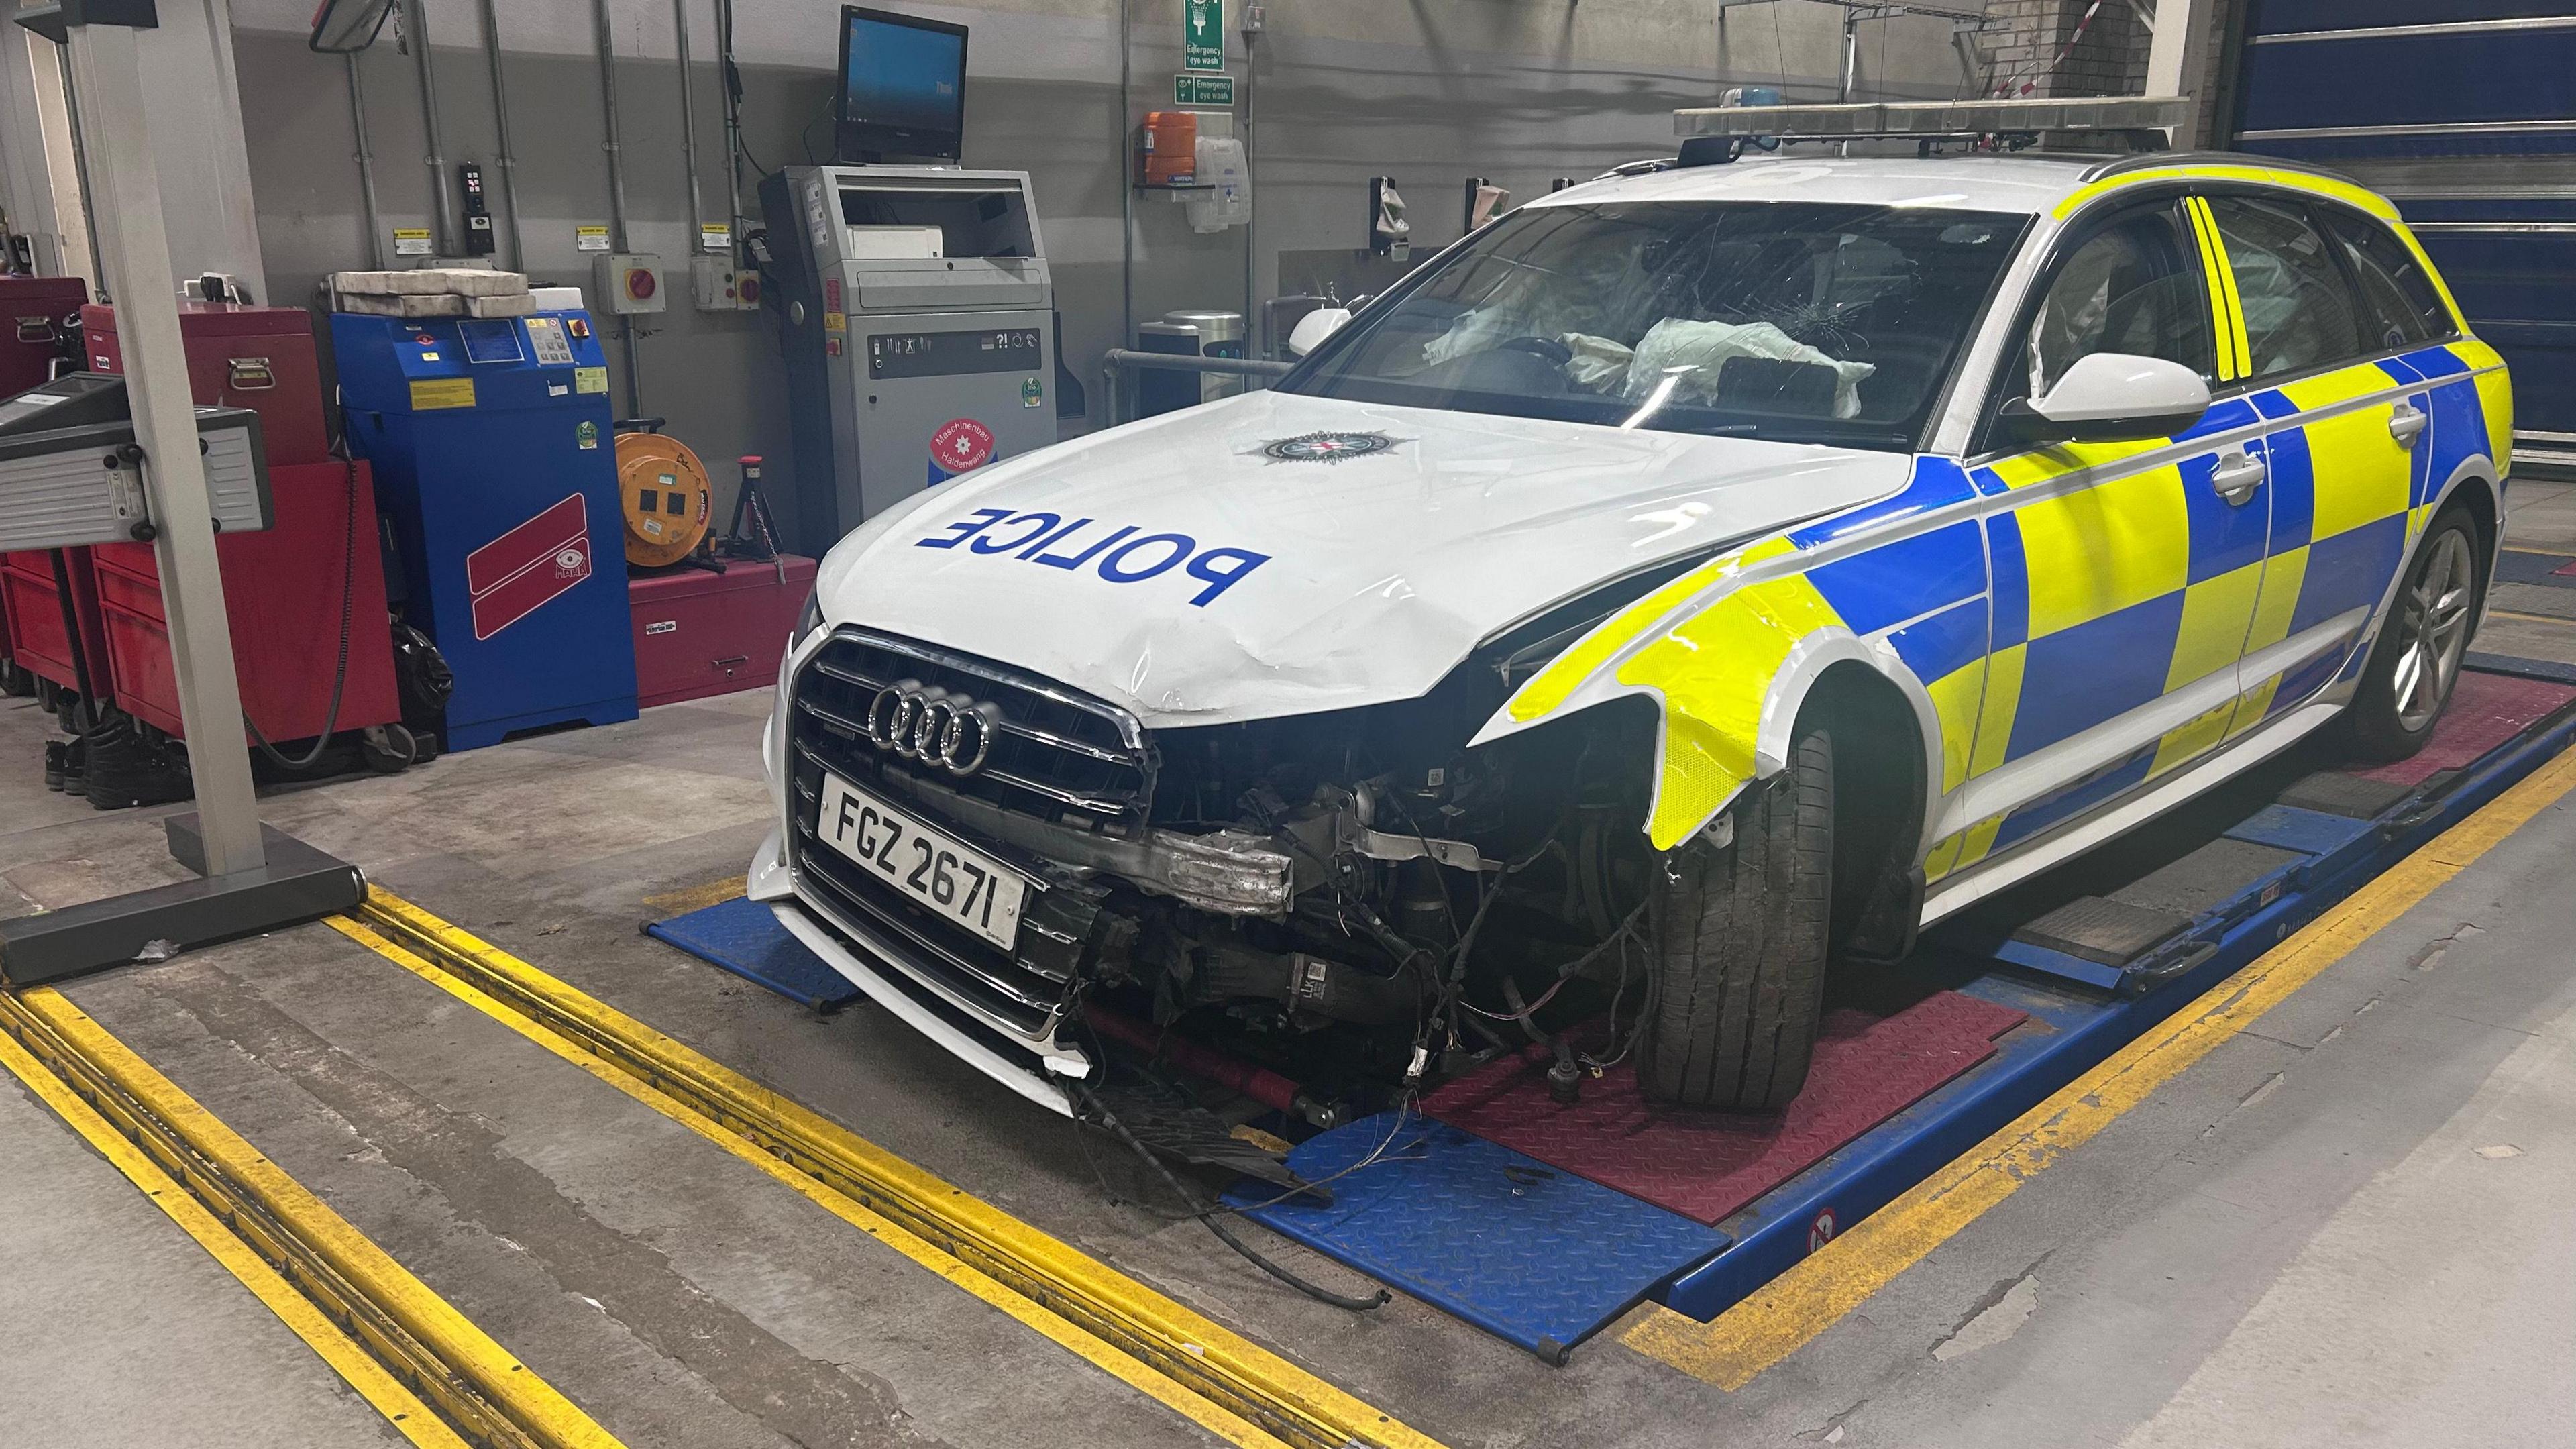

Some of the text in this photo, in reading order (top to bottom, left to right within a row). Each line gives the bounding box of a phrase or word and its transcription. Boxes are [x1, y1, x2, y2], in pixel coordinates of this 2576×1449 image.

[1187, 44, 1221, 56] Emergency
[1189, 58, 1201, 66] eye
[1197, 80, 1230, 92] Emergency
[935, 421, 990, 446] Maschinenbau
[941, 448, 986, 468] Haldenwang
[555, 561, 587, 579] MAHA
[837, 791, 998, 929] FGZ 2671
